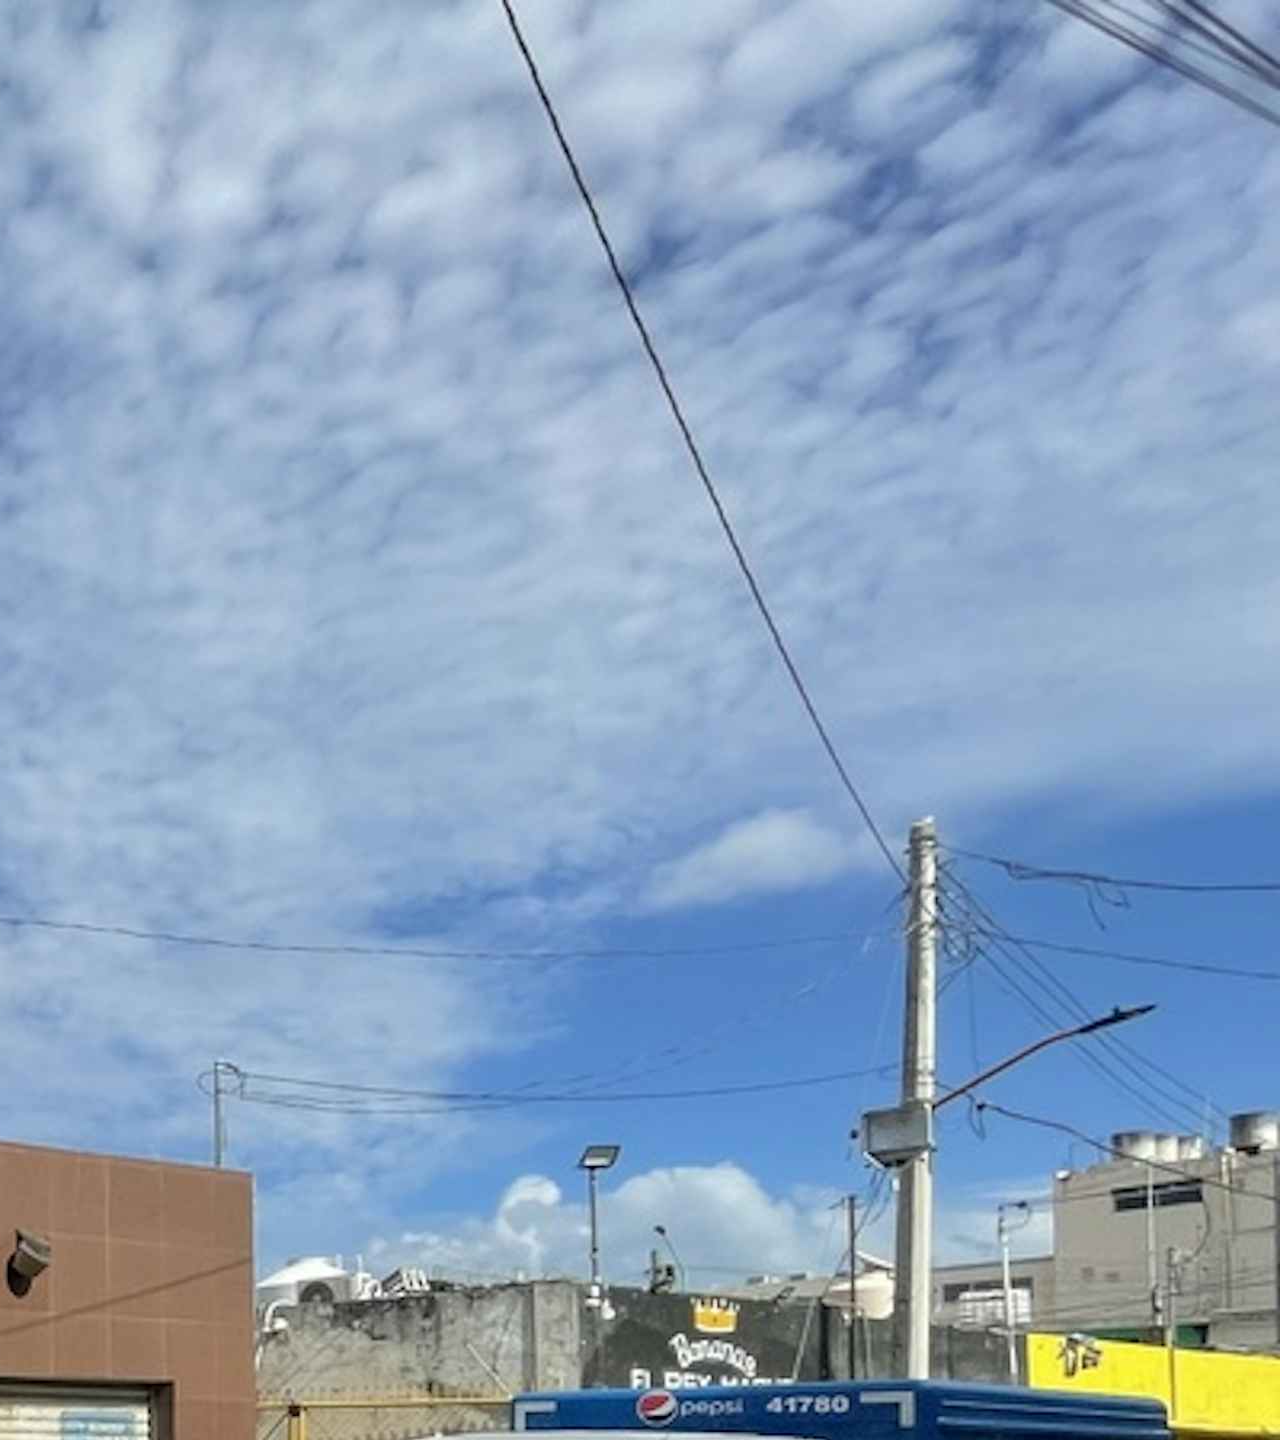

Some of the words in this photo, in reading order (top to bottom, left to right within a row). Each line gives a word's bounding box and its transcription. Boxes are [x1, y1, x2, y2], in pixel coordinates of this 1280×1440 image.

[670, 1333, 757, 1377] Bananas
[680, 1399, 744, 1416] pepsi
[766, 1395, 850, 1414] 41780
